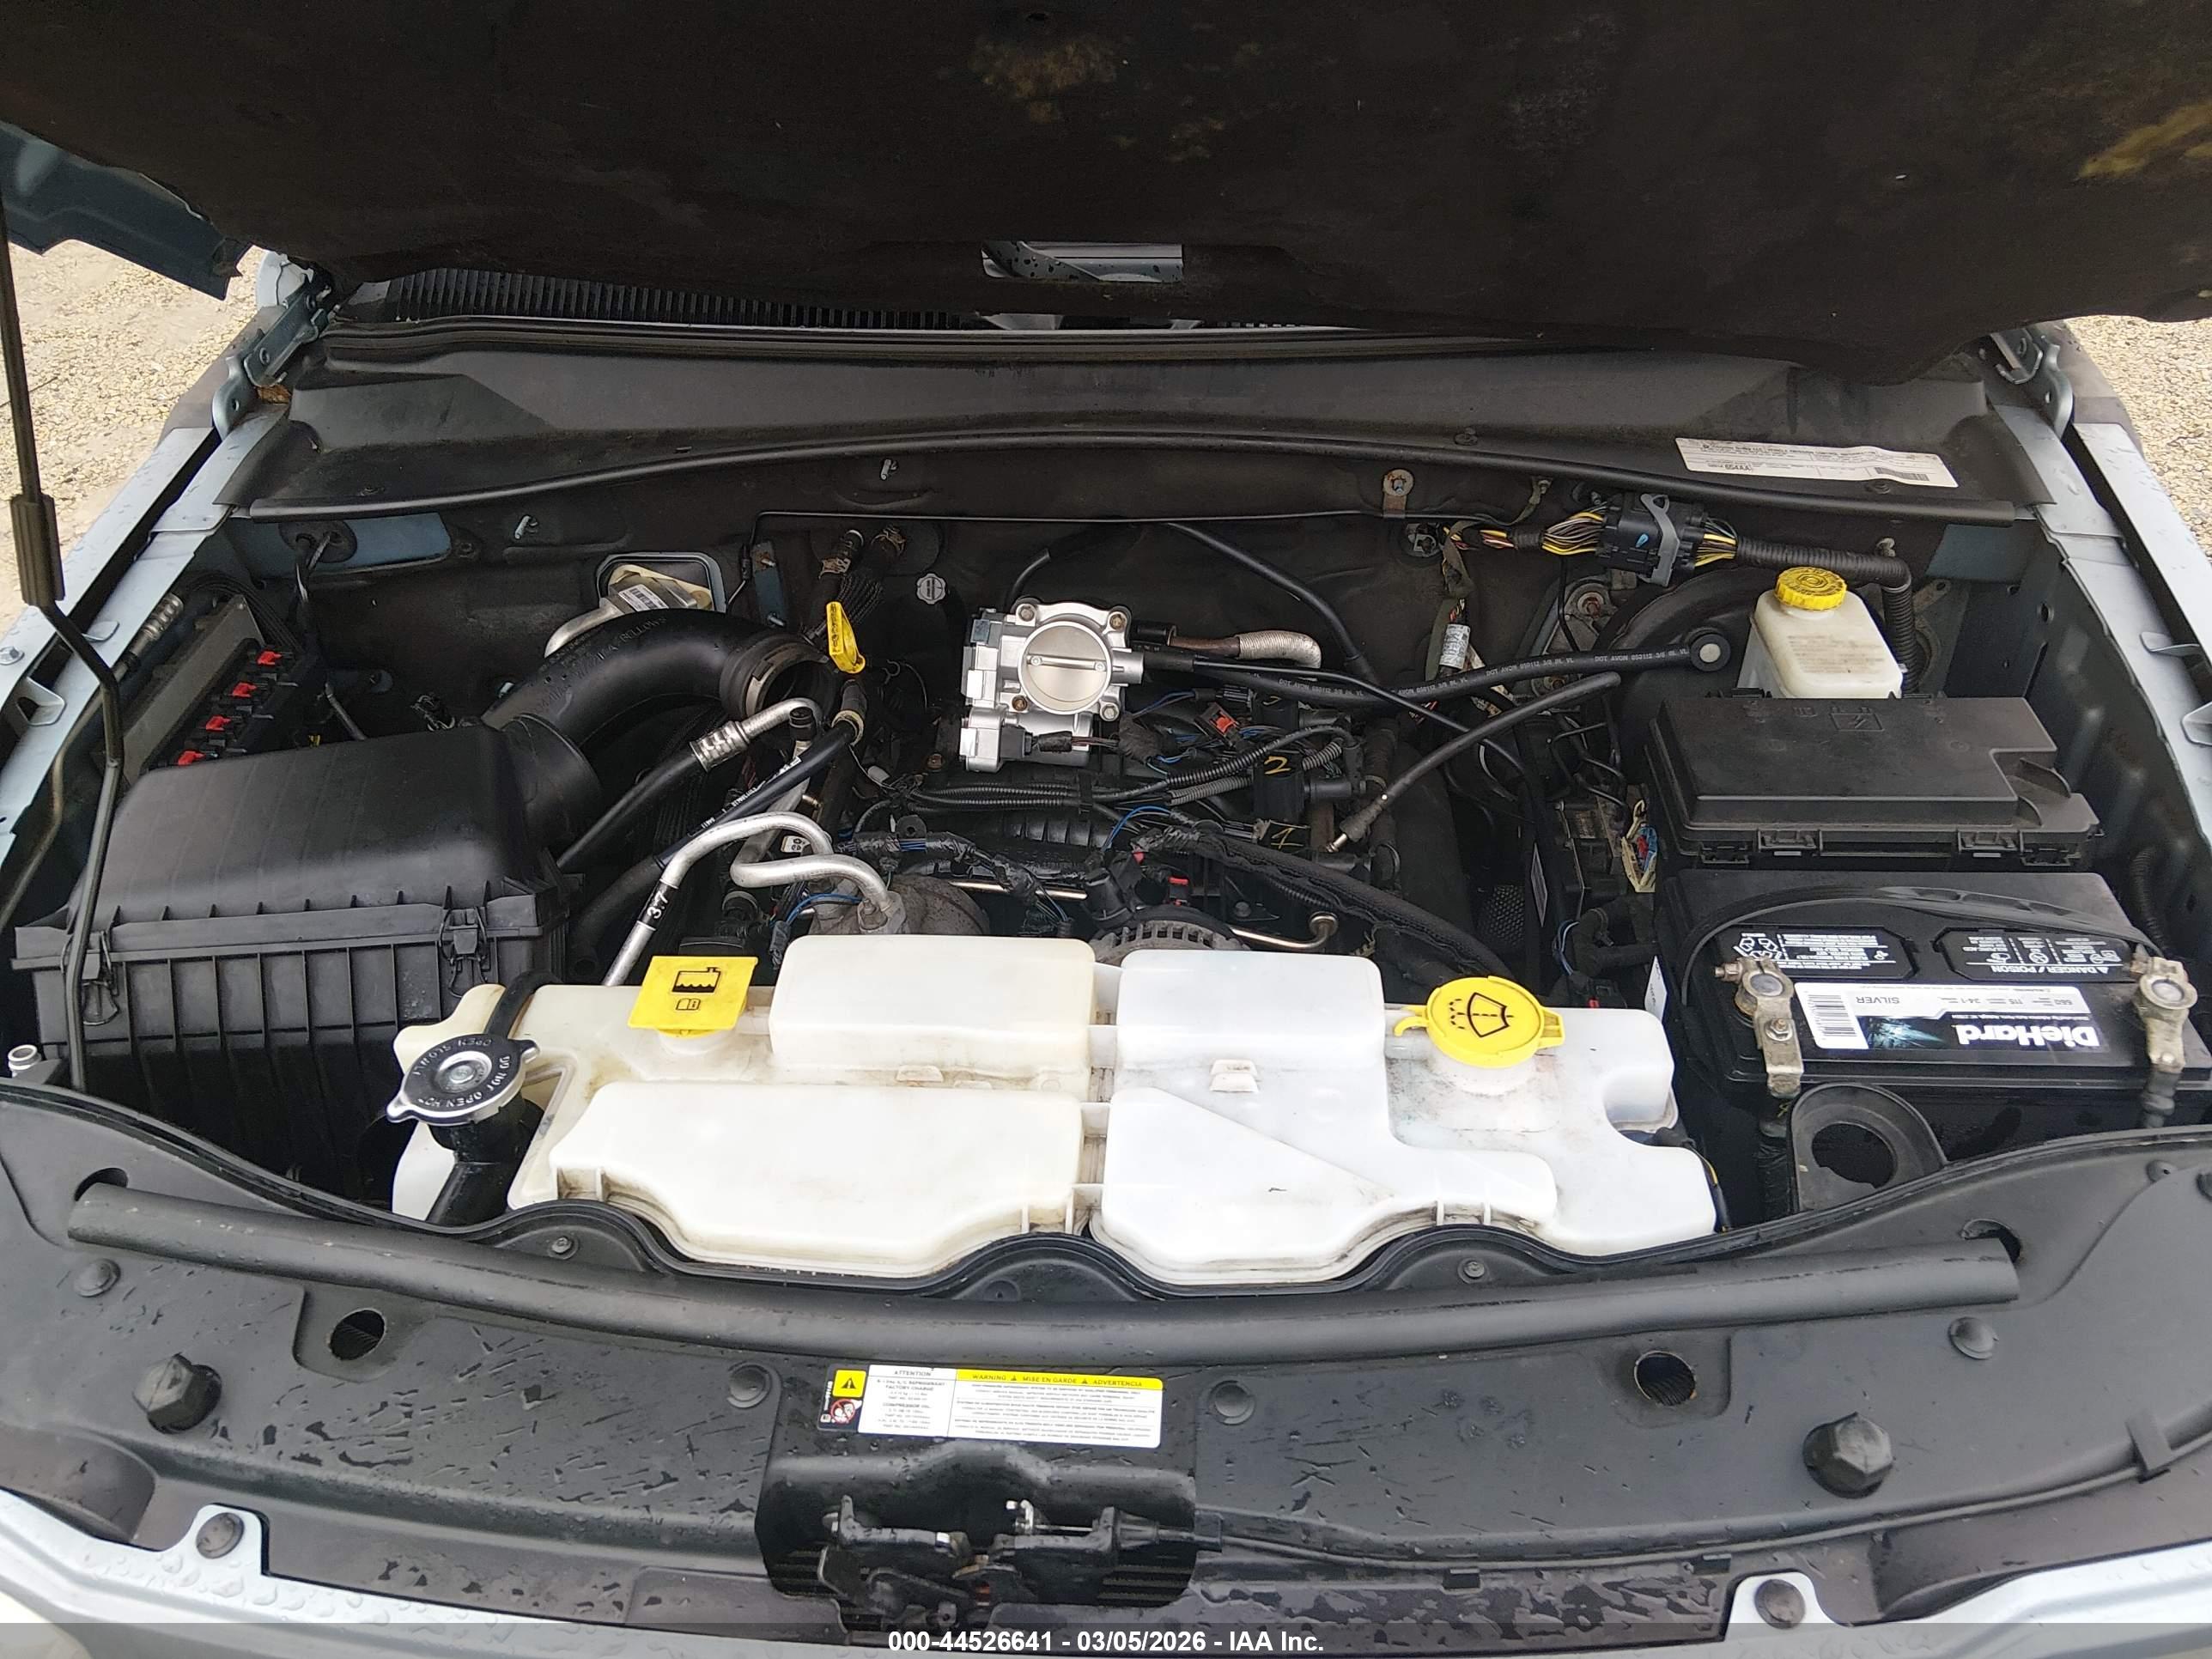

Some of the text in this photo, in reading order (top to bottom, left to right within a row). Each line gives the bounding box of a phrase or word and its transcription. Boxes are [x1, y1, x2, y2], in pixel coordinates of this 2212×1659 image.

[1500, 665, 1517, 673] AVON
[1263, 755, 1292, 775] 2
[1990, 965, 2039, 974] POISON
[2045, 966, 2097, 975] DANGER
[1856, 996, 1900, 1005] SILVER
[1954, 1024, 2100, 1048] DieHard
[458, 1037, 493, 1048] OPEN
[486, 1072, 508, 1092] NOT
[446, 1091, 483, 1109] OPEN
